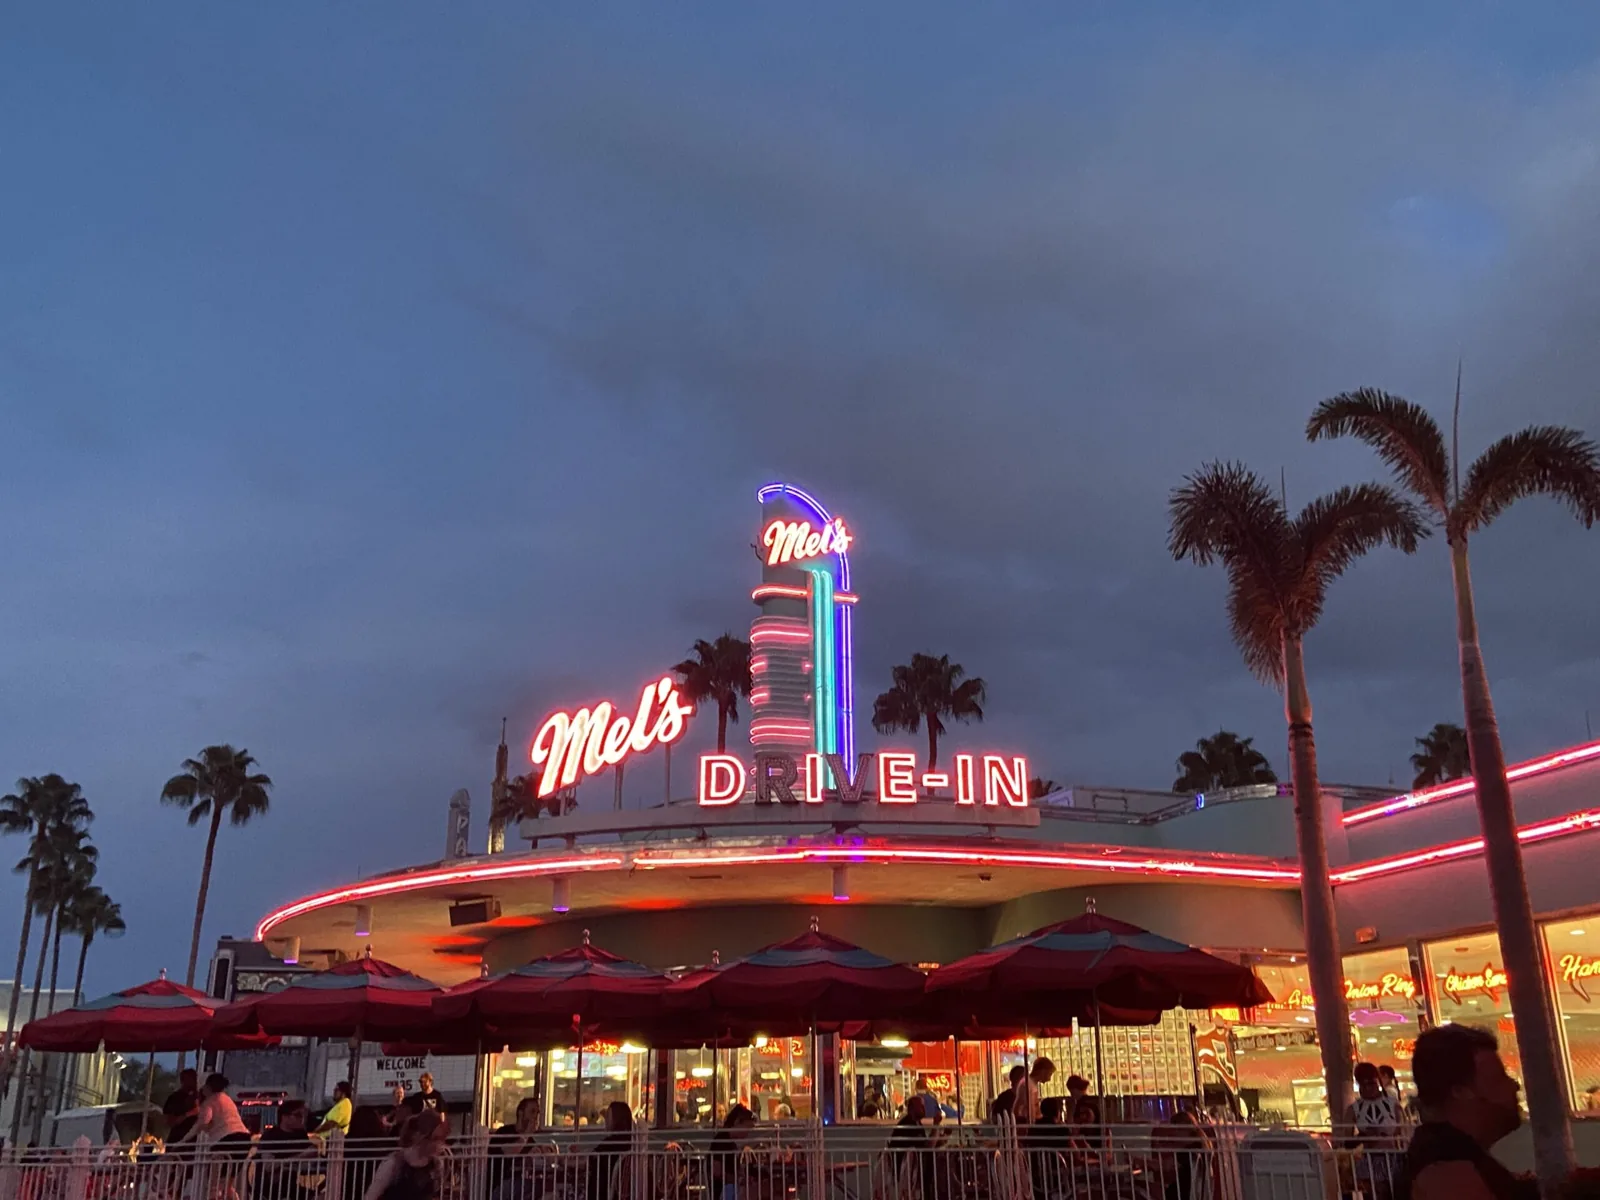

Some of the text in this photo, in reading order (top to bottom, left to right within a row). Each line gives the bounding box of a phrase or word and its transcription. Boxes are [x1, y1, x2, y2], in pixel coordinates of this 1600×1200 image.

[763, 518, 853, 565] Mel's
[531, 677, 694, 799] Mel's
[699, 752, 1028, 807] DRIVE-IN
[376, 1057, 427, 1070] WELCOME
